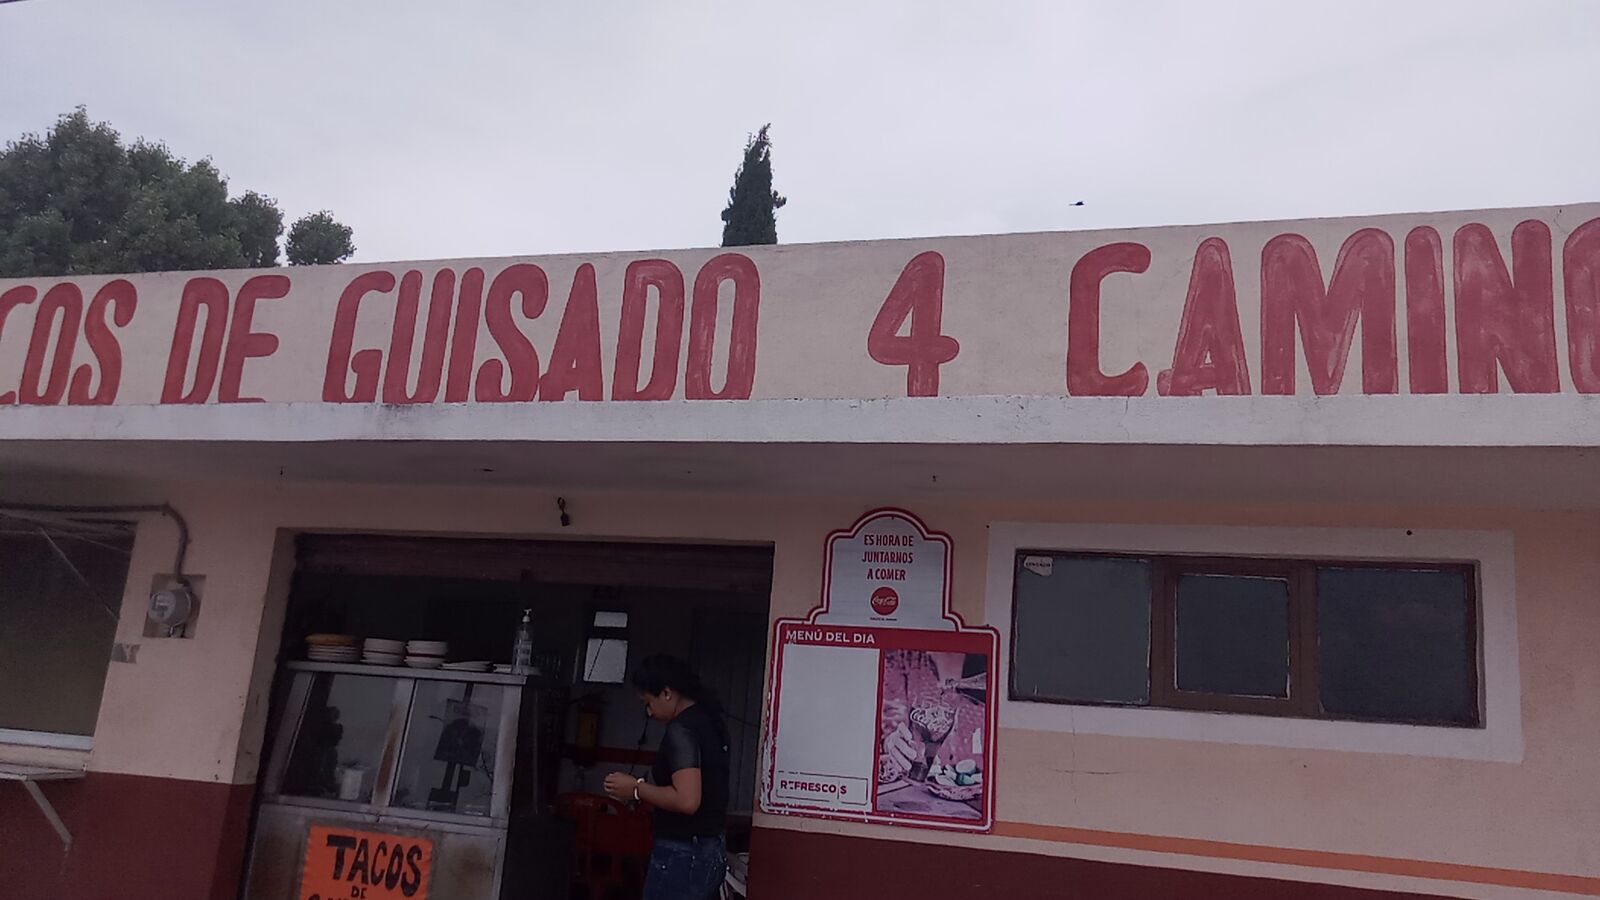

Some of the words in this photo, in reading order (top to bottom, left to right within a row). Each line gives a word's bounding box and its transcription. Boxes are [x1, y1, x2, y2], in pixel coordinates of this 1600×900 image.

[161, 273, 292, 404] DE
[322, 252, 761, 403] GUISADO
[867, 250, 960, 398] 4
[864, 534, 874, 546] ES
[876, 534, 901, 547] HORA
[902, 535, 914, 547] DE
[861, 551, 914, 564] JUNTARNOS
[867, 568, 873, 580] A
[875, 568, 906, 581] COMER
[786, 628, 823, 643] MENÚ
[826, 631, 850, 643] DEL
[326, 834, 423, 897] TACOS
[351, 885, 368, 899] DE
